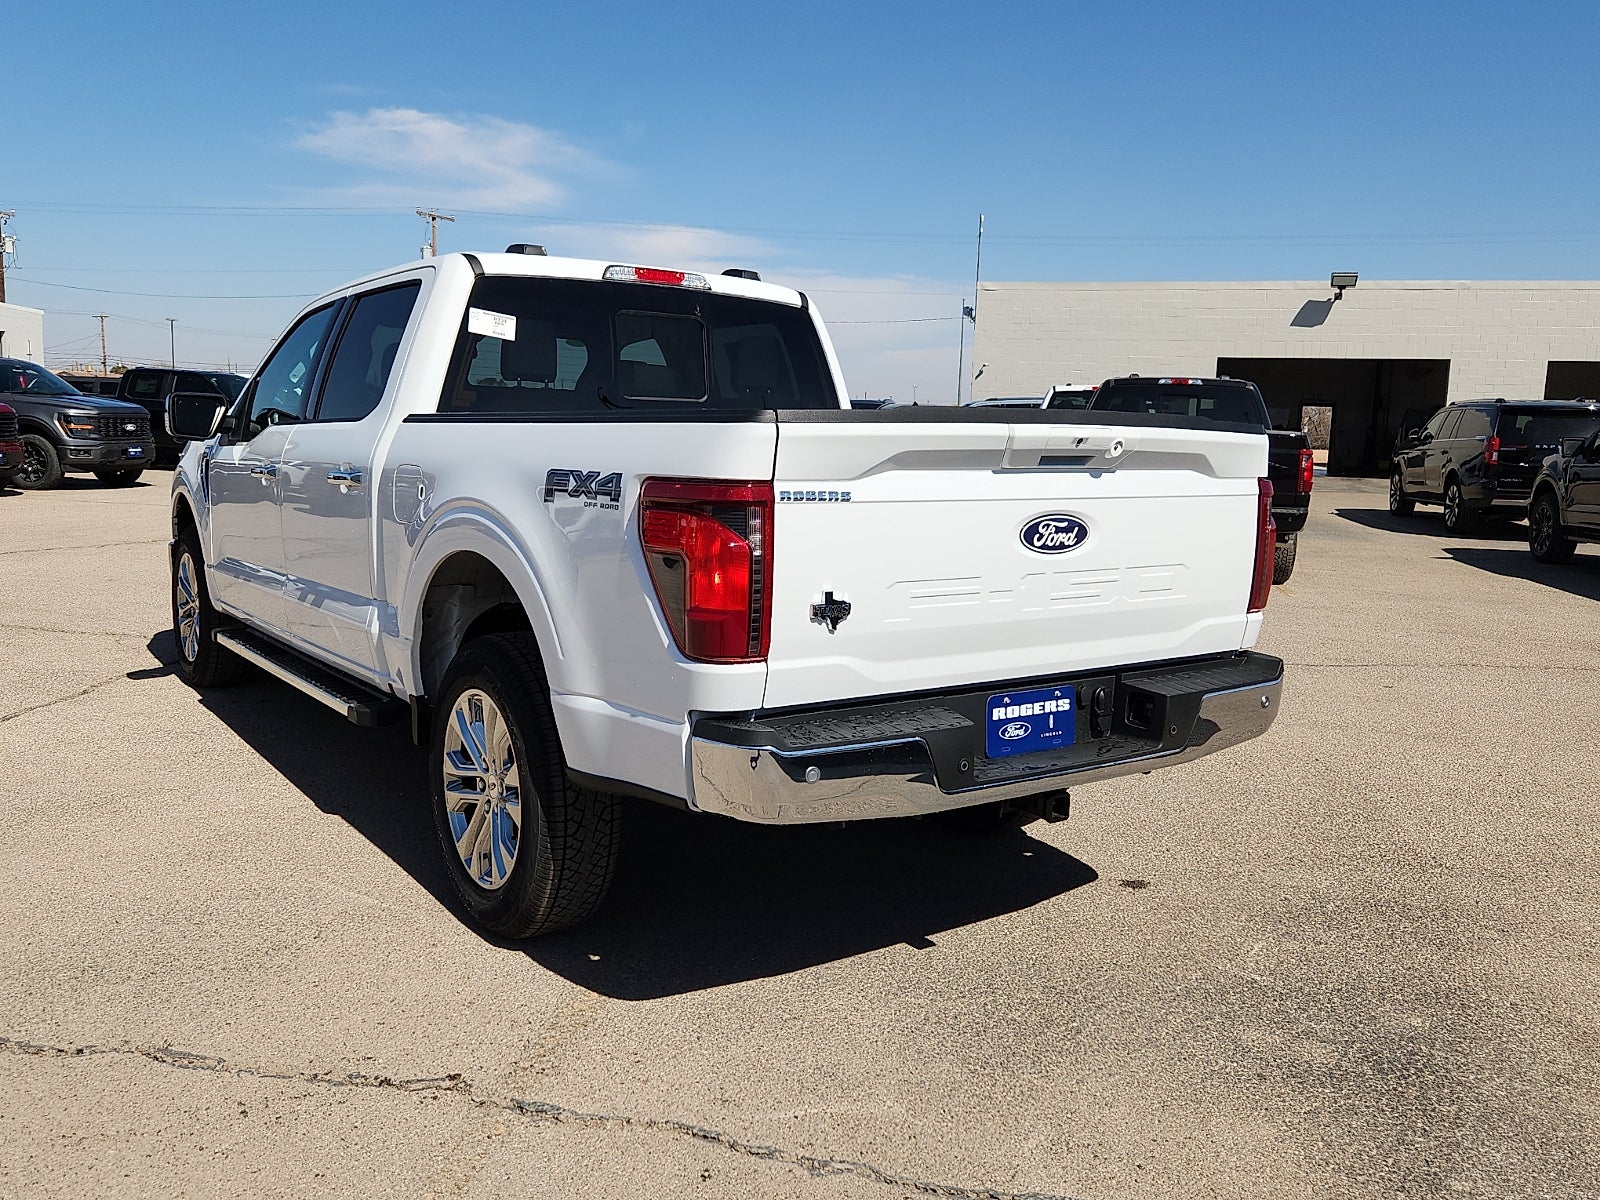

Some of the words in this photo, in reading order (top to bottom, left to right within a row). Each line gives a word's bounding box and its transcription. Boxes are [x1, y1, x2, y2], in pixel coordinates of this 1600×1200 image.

[544, 469, 623, 503] FX4
[779, 491, 852, 502] ROGERS
[600, 502, 619, 510] ROAD
[1033, 521, 1079, 547] Ford
[992, 699, 1071, 721] ROGERS
